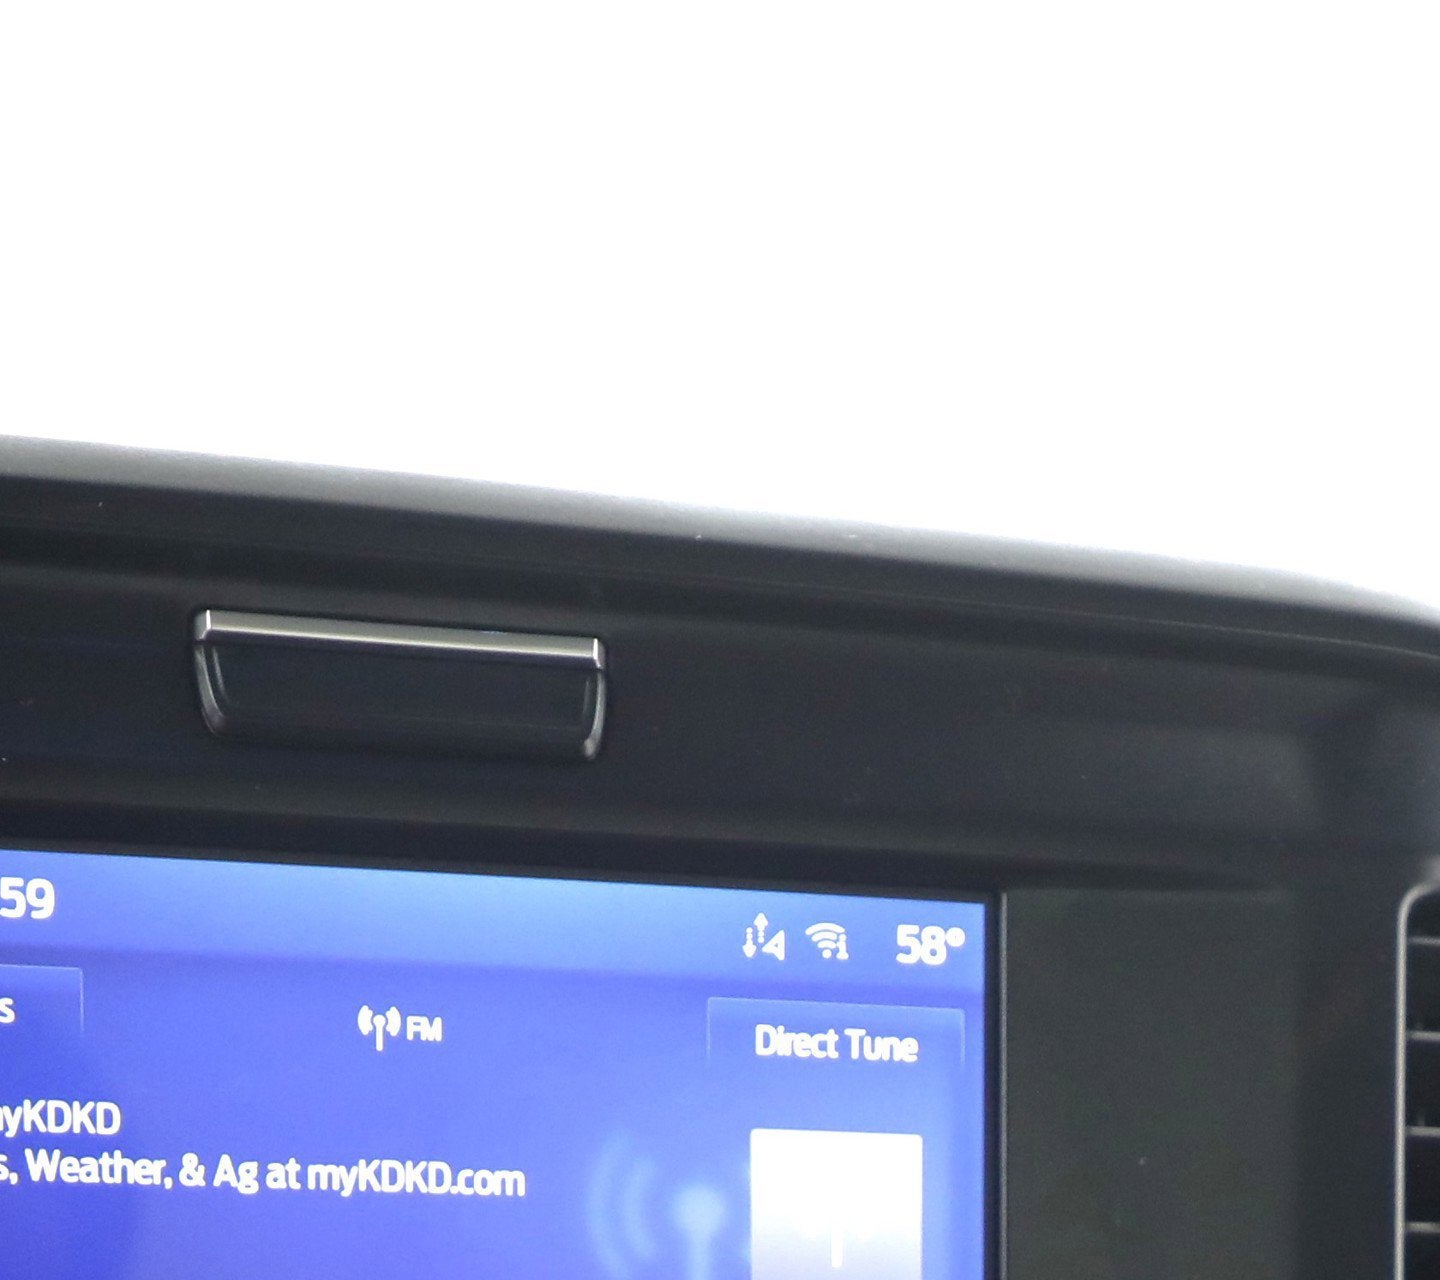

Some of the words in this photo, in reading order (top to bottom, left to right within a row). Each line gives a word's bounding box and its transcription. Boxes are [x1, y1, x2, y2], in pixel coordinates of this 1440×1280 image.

[406, 1015, 443, 1042] FM
[755, 1023, 839, 1059] Direct
[843, 1028, 919, 1063] Tune
[24, 1148, 173, 1190] Weather,
[178, 1152, 206, 1187] &
[212, 1153, 260, 1195] Ag
[265, 1157, 302, 1190] at
[307, 1158, 526, 1198] myKDKD.com
